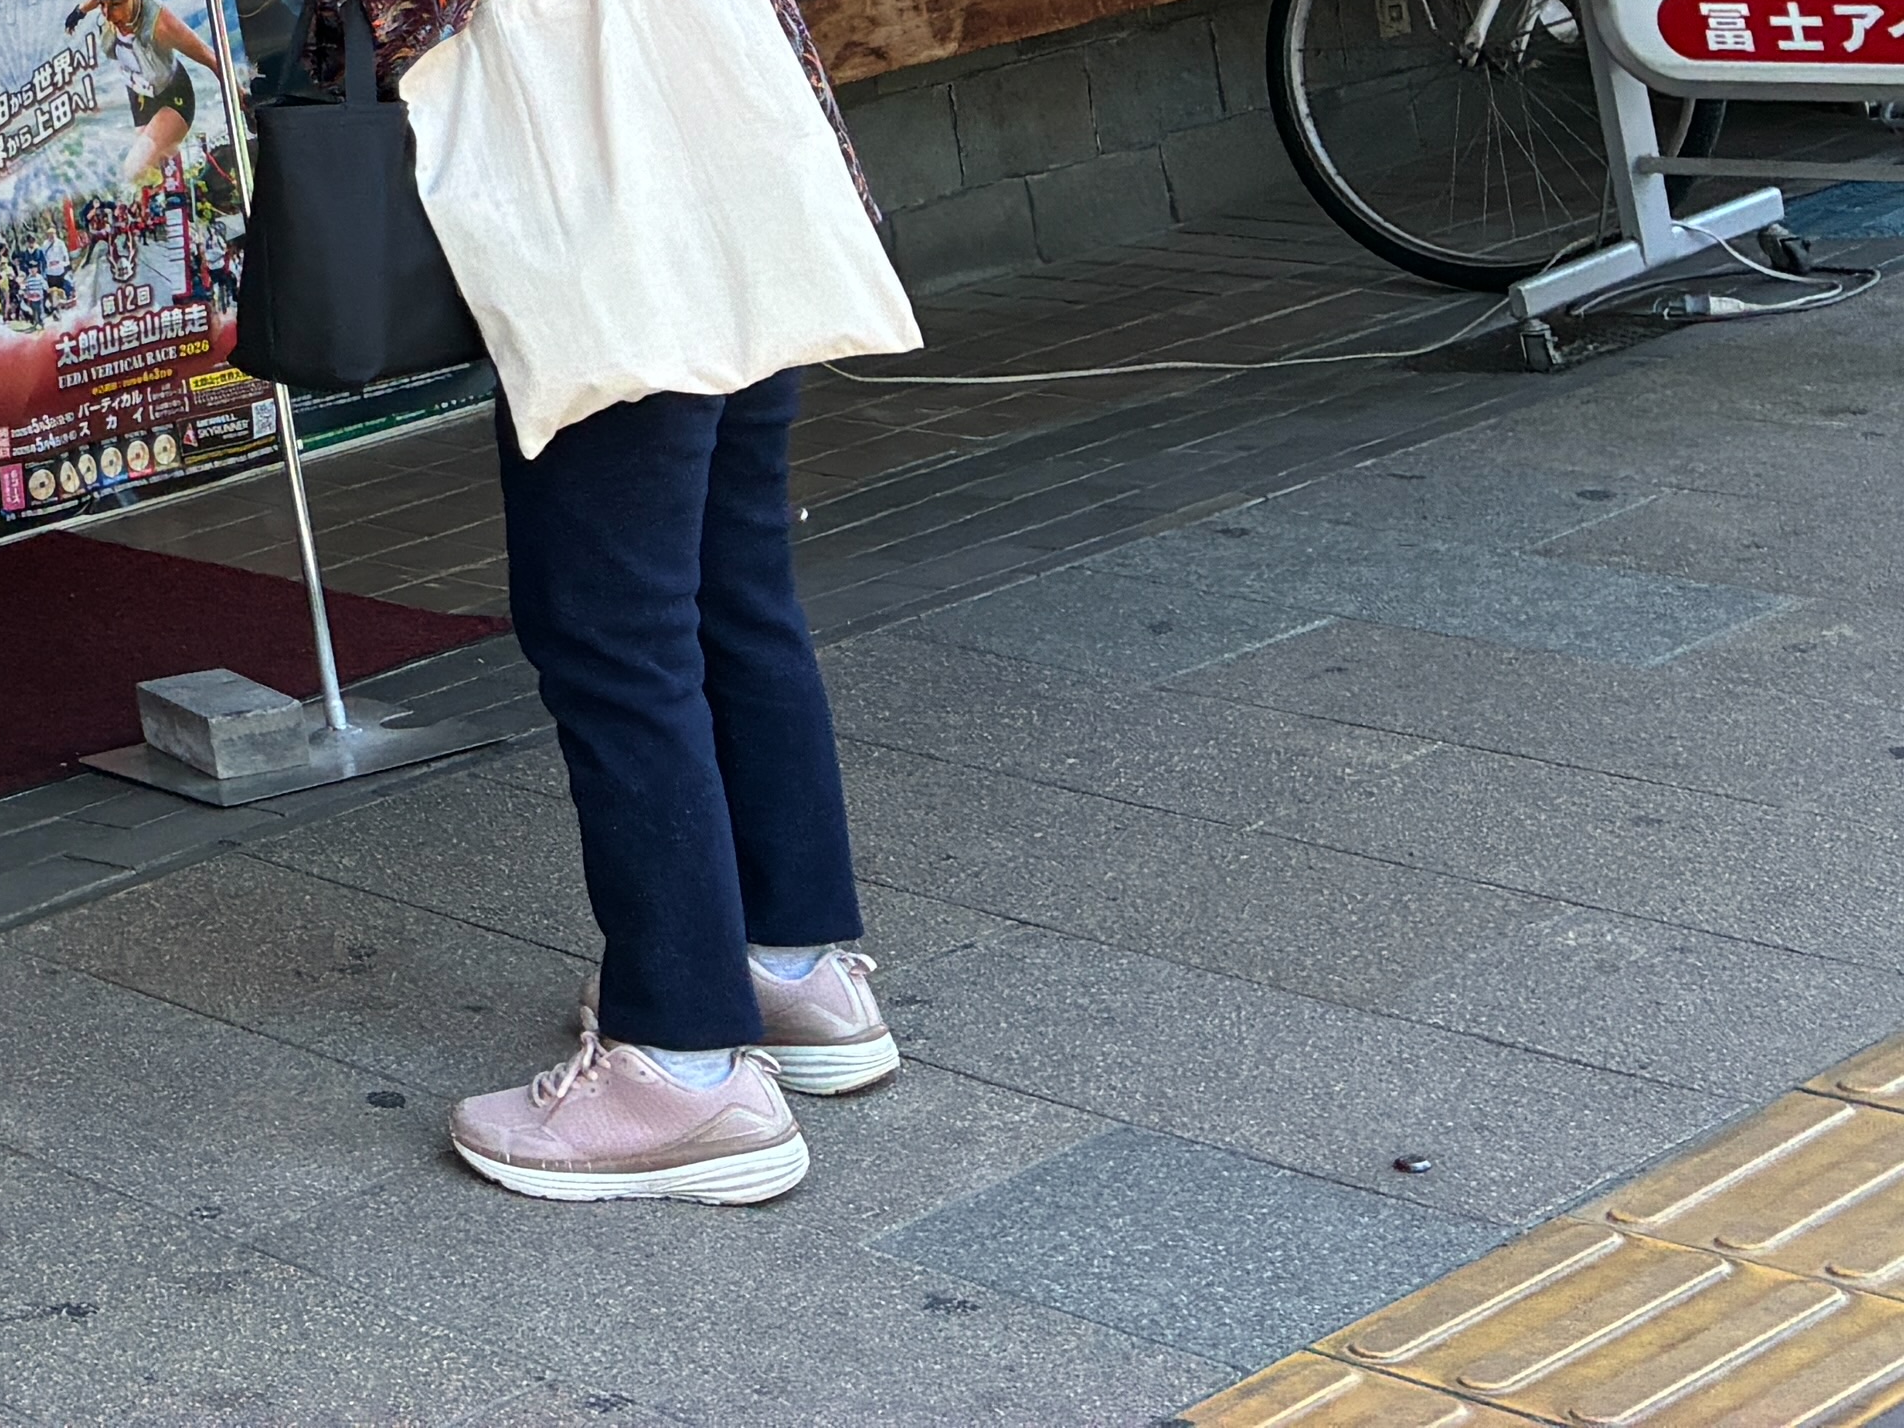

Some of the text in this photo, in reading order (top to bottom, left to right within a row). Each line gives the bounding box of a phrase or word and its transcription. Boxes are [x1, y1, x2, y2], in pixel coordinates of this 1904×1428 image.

[100, 284, 152, 318] 第12回
[54, 302, 210, 369] 太郎山登山競走
[92, 356, 145, 381] VERTICAL
[146, 345, 178, 366] RACE
[78, 390, 143, 418] バーティカル
